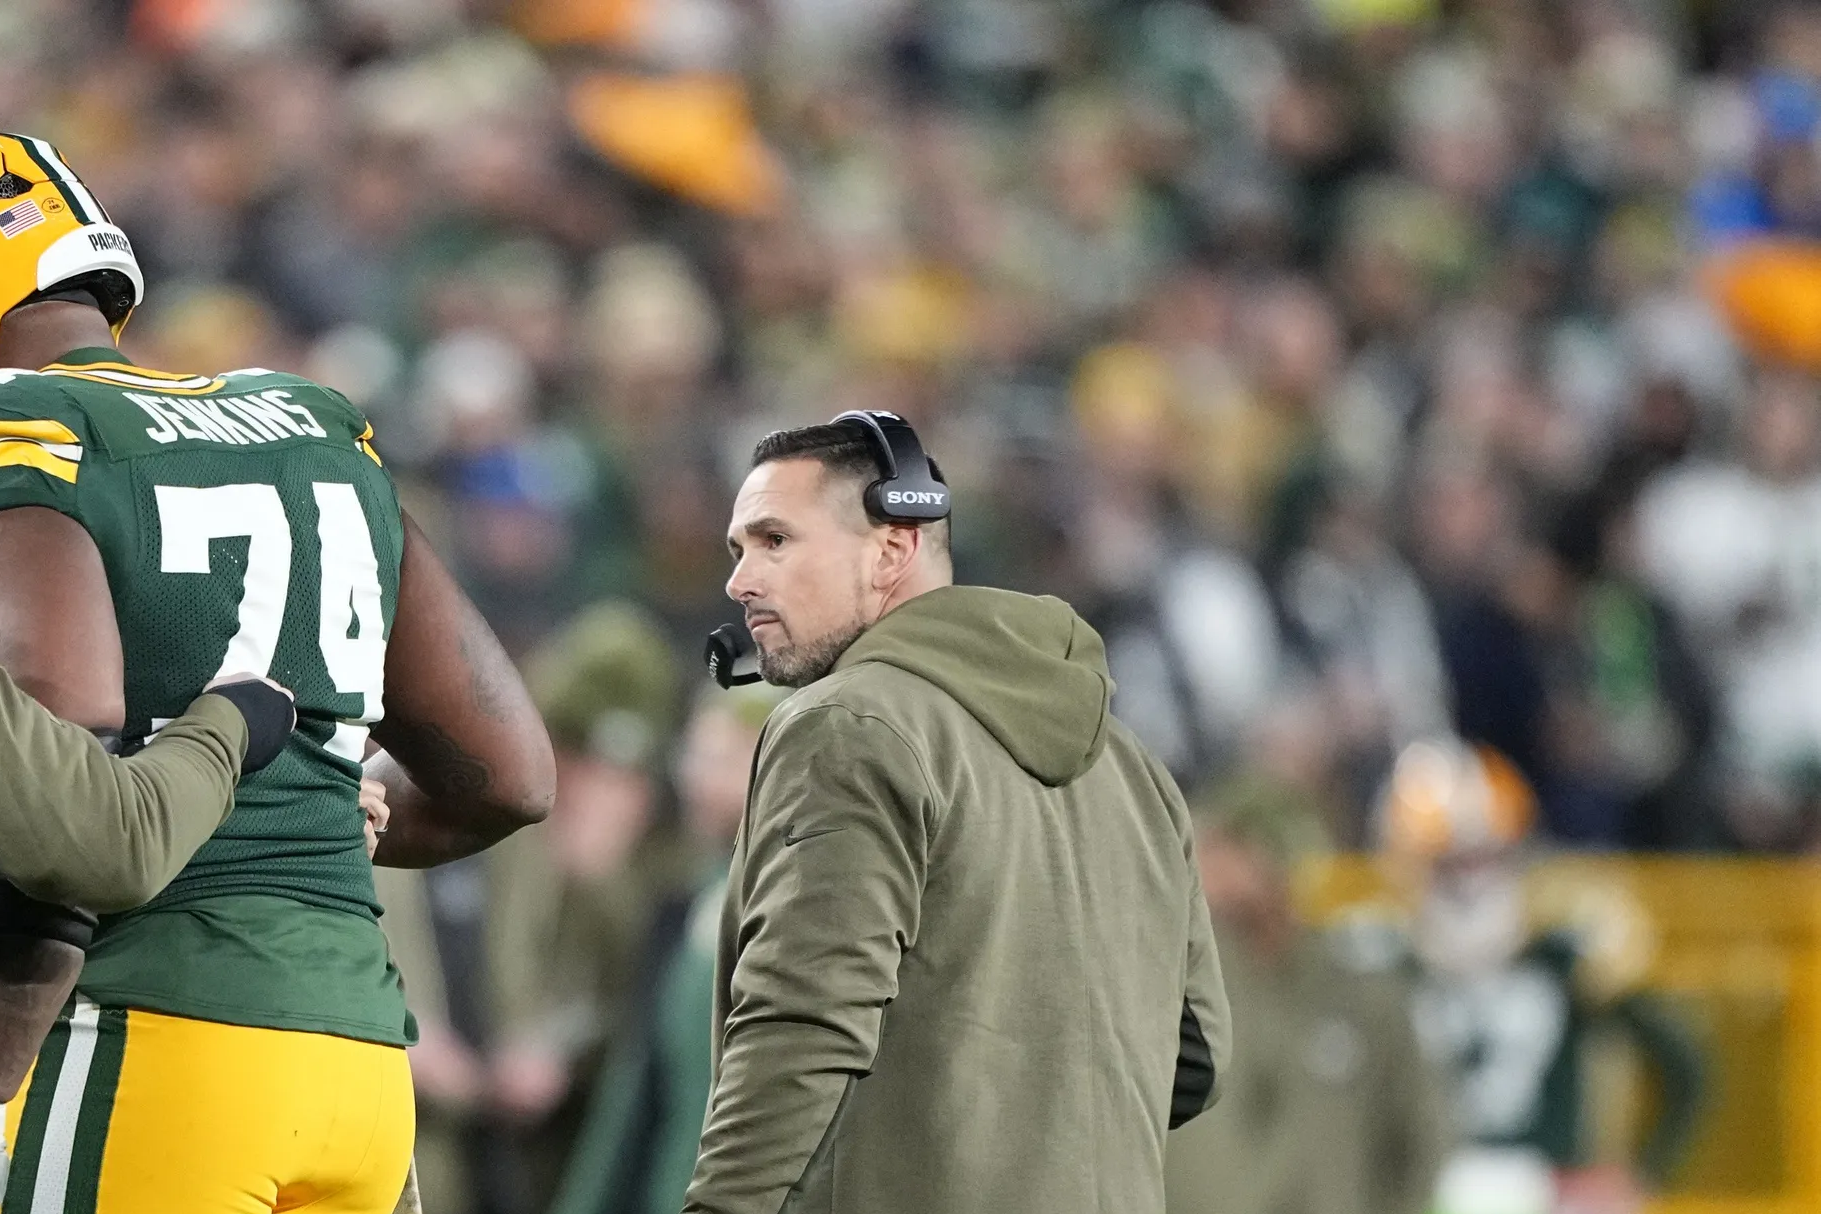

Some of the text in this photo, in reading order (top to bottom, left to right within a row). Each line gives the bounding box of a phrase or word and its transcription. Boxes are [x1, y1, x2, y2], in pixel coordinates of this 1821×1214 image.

[122, 390, 328, 446] JENKINS
[886, 490, 946, 506] SONY
[153, 481, 386, 763] 74
